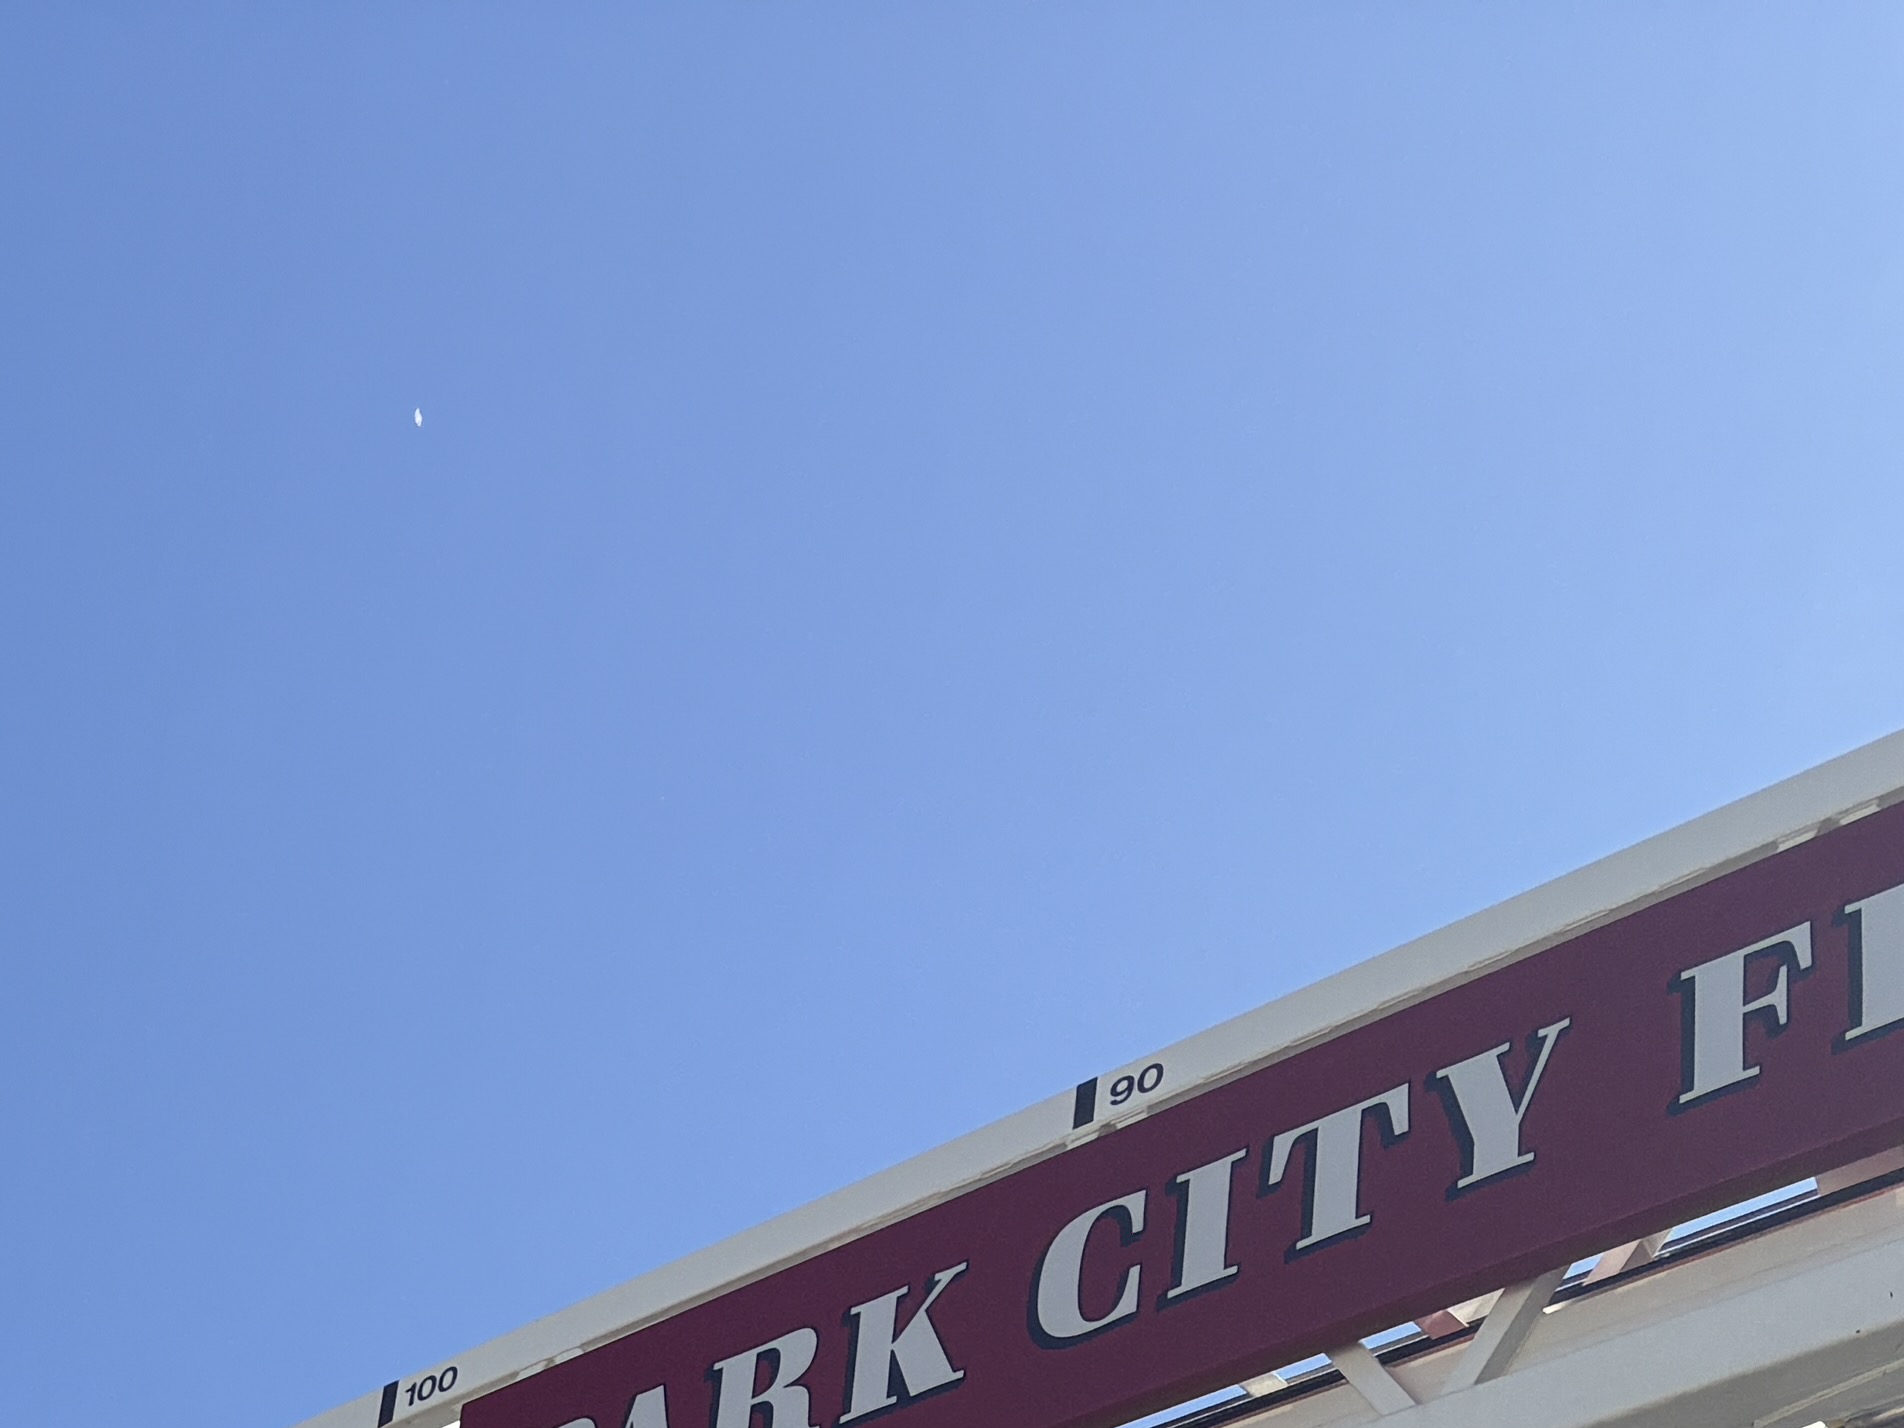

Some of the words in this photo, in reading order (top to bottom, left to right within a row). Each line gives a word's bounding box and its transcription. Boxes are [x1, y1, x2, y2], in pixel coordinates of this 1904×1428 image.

[1109, 1062, 1164, 1106] 90
[1028, 1017, 1571, 1339] CITY
[405, 1366, 458, 1406] 100
